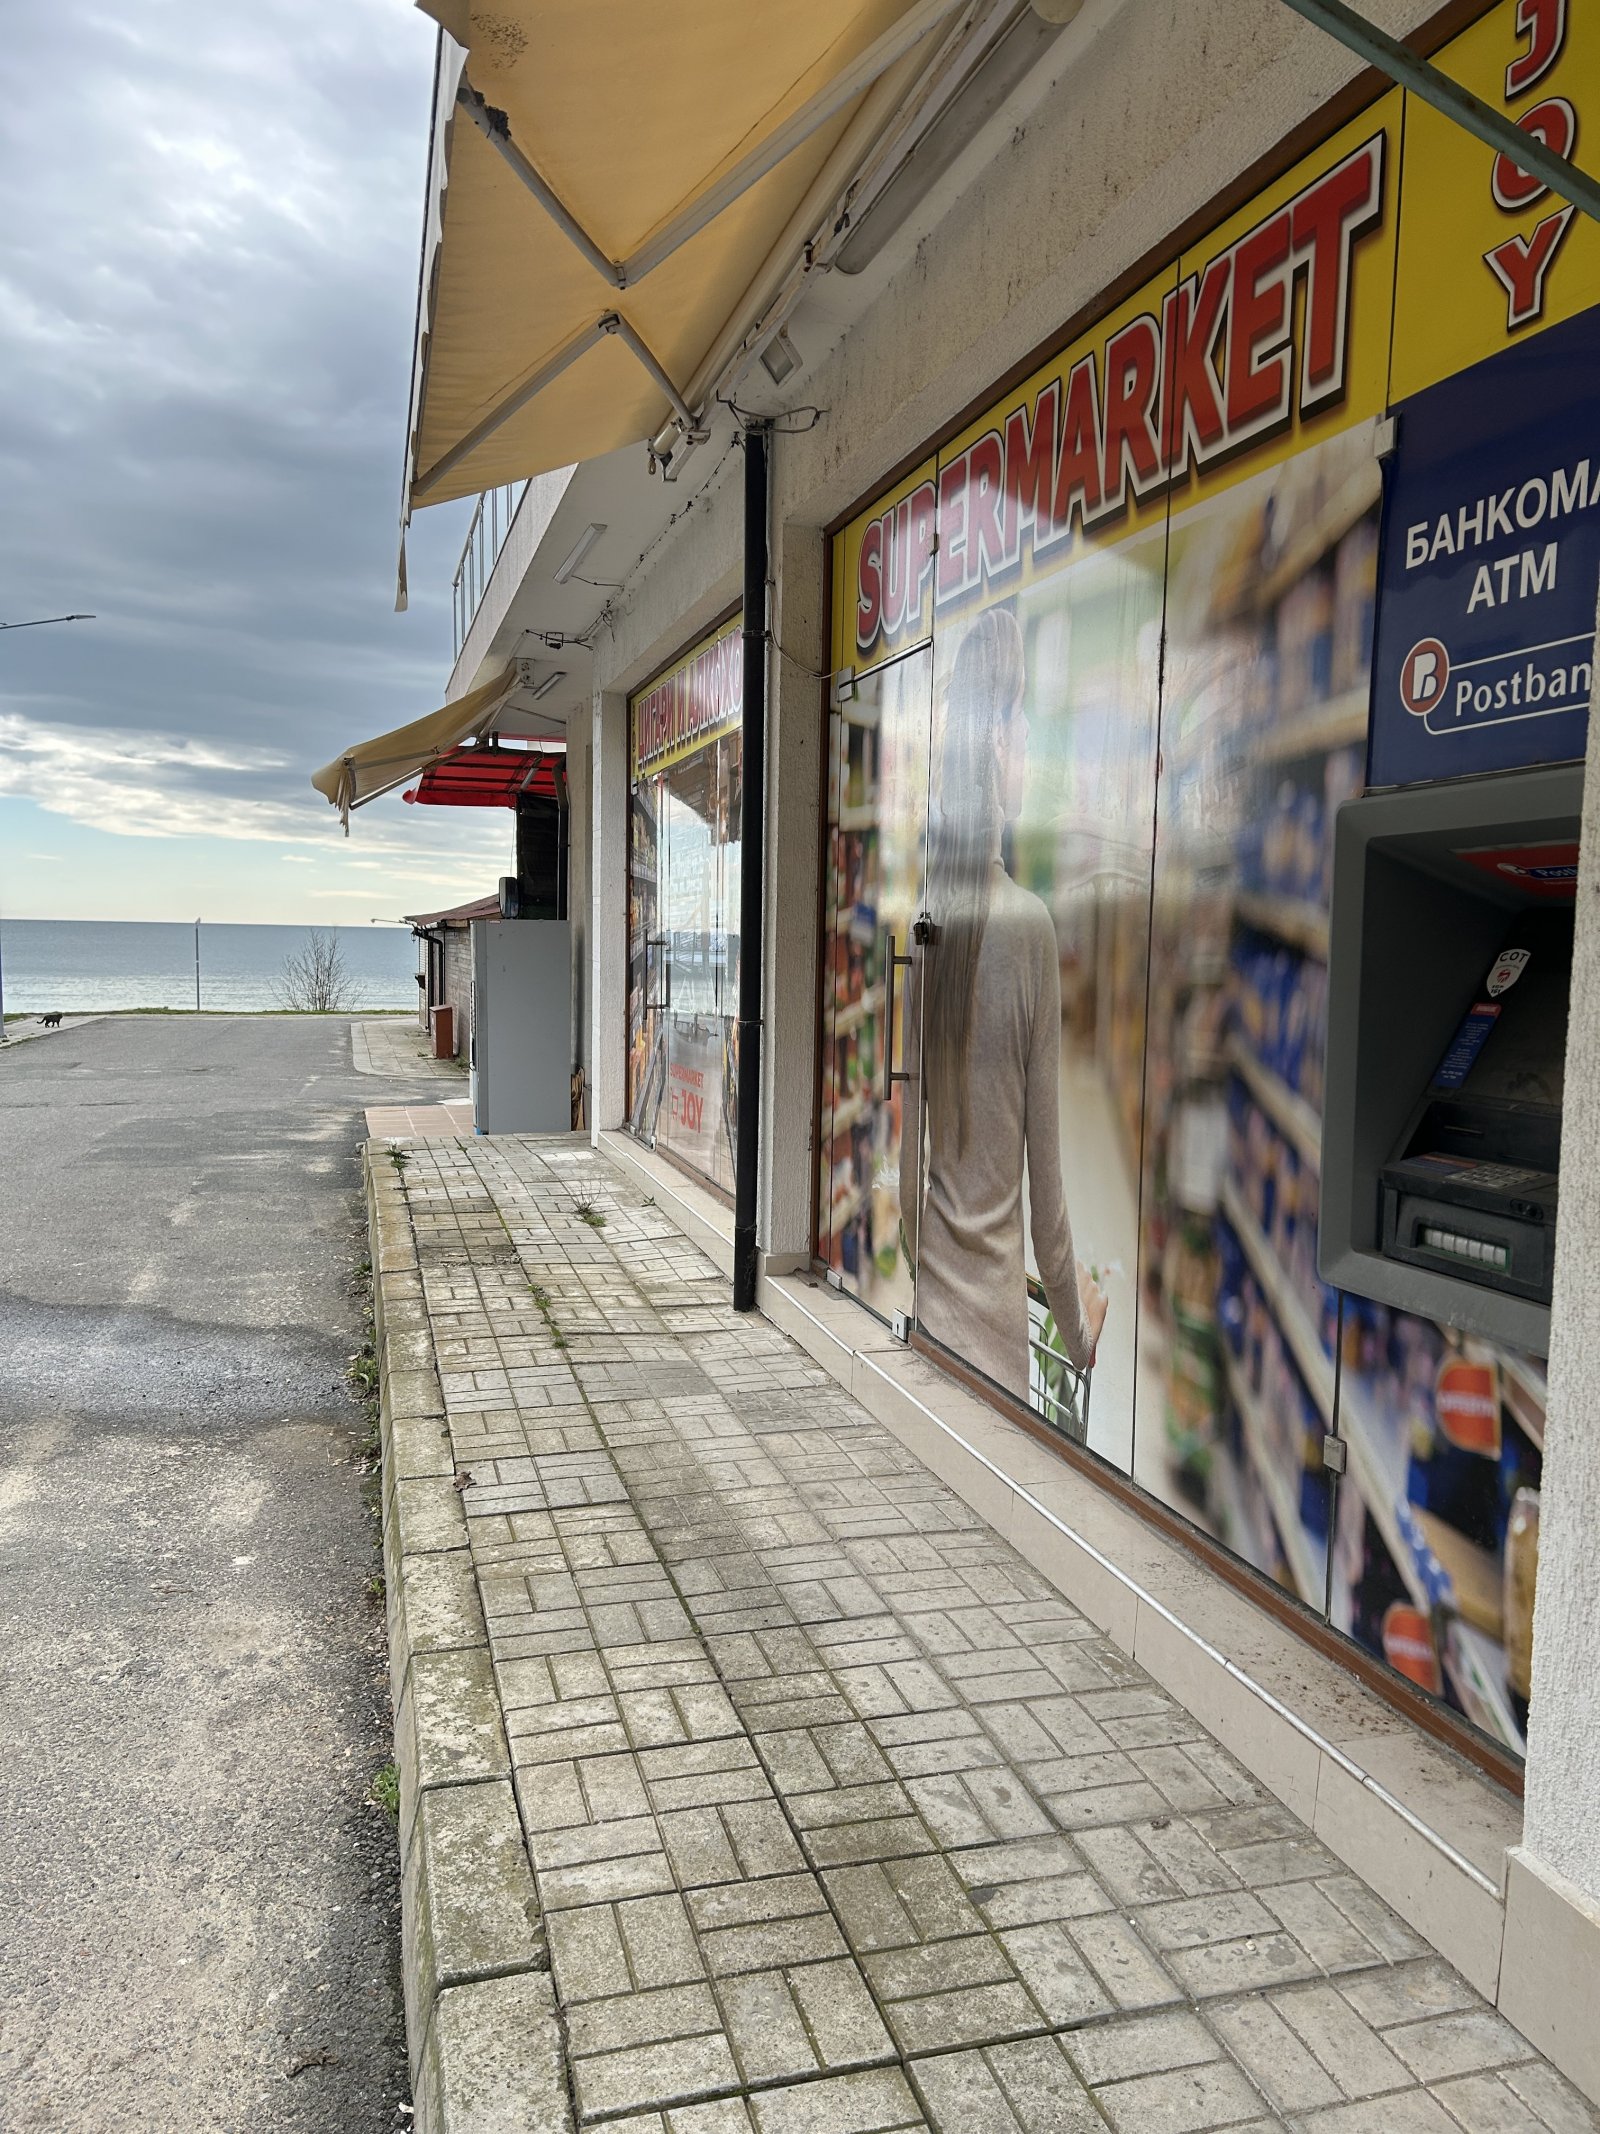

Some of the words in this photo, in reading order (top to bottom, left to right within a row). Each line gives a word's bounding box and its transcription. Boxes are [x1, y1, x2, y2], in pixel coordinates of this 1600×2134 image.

[856, 130, 1387, 652] SUPERMARKET
[1455, 661, 1592, 717] Postban
[638, 675, 676, 769] ЦИГАРИ
[677, 667, 687, 743] И
[670, 1064, 704, 1088] SUPERMARKET
[681, 1089, 703, 1133] JOY
